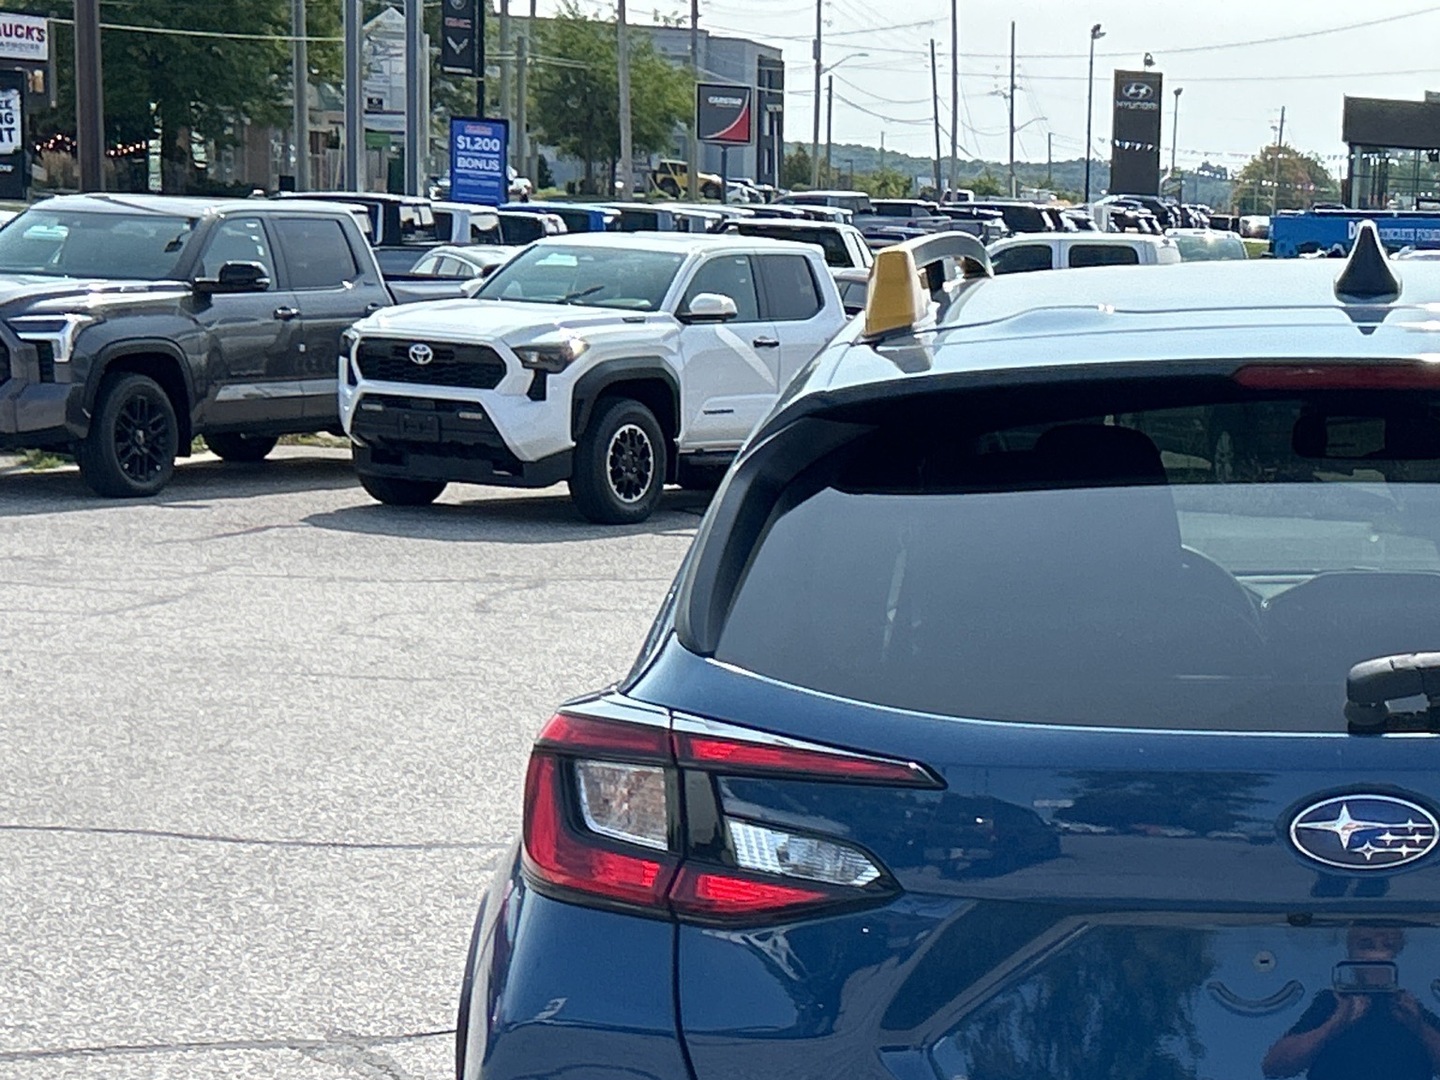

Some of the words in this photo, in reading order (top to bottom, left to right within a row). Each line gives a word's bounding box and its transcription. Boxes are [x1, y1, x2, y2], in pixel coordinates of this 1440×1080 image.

[0, 23, 46, 43] UCK'S
[456, 135, 500, 152] $1,200
[456, 156, 500, 171] BONUS
